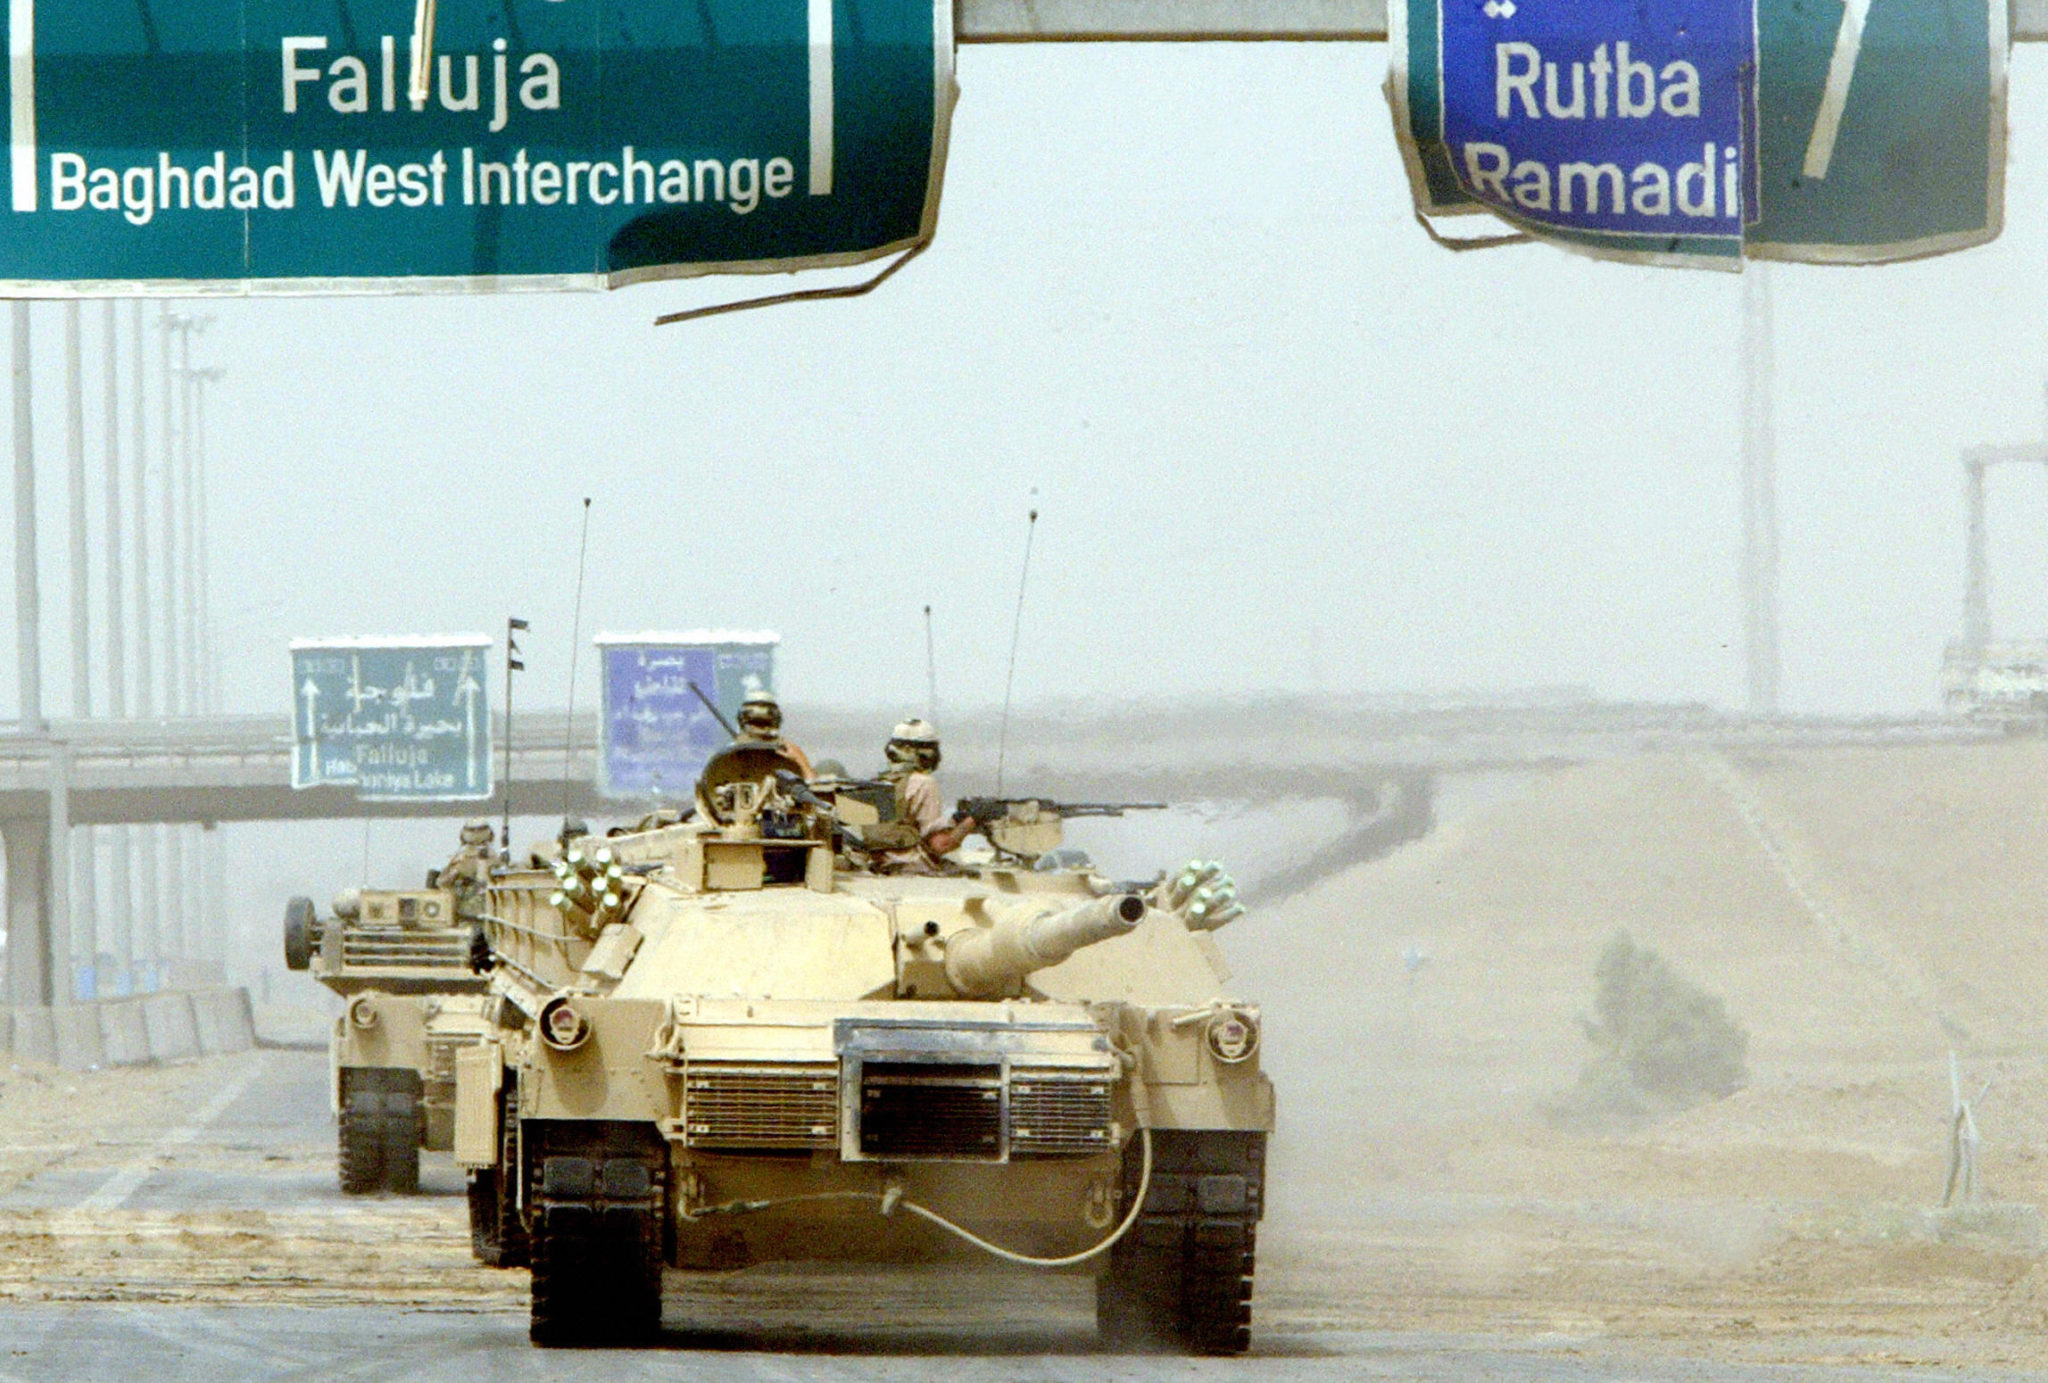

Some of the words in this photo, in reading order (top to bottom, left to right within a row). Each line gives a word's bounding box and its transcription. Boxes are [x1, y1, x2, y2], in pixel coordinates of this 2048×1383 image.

[1495, 41, 1701, 119] Rutba
[51, 150, 295, 225] Baghdad
[314, 150, 447, 207] West
[462, 146, 794, 213] Interchange
[1463, 142, 1738, 218] Ramadi
[355, 743, 429, 768] Falluja
